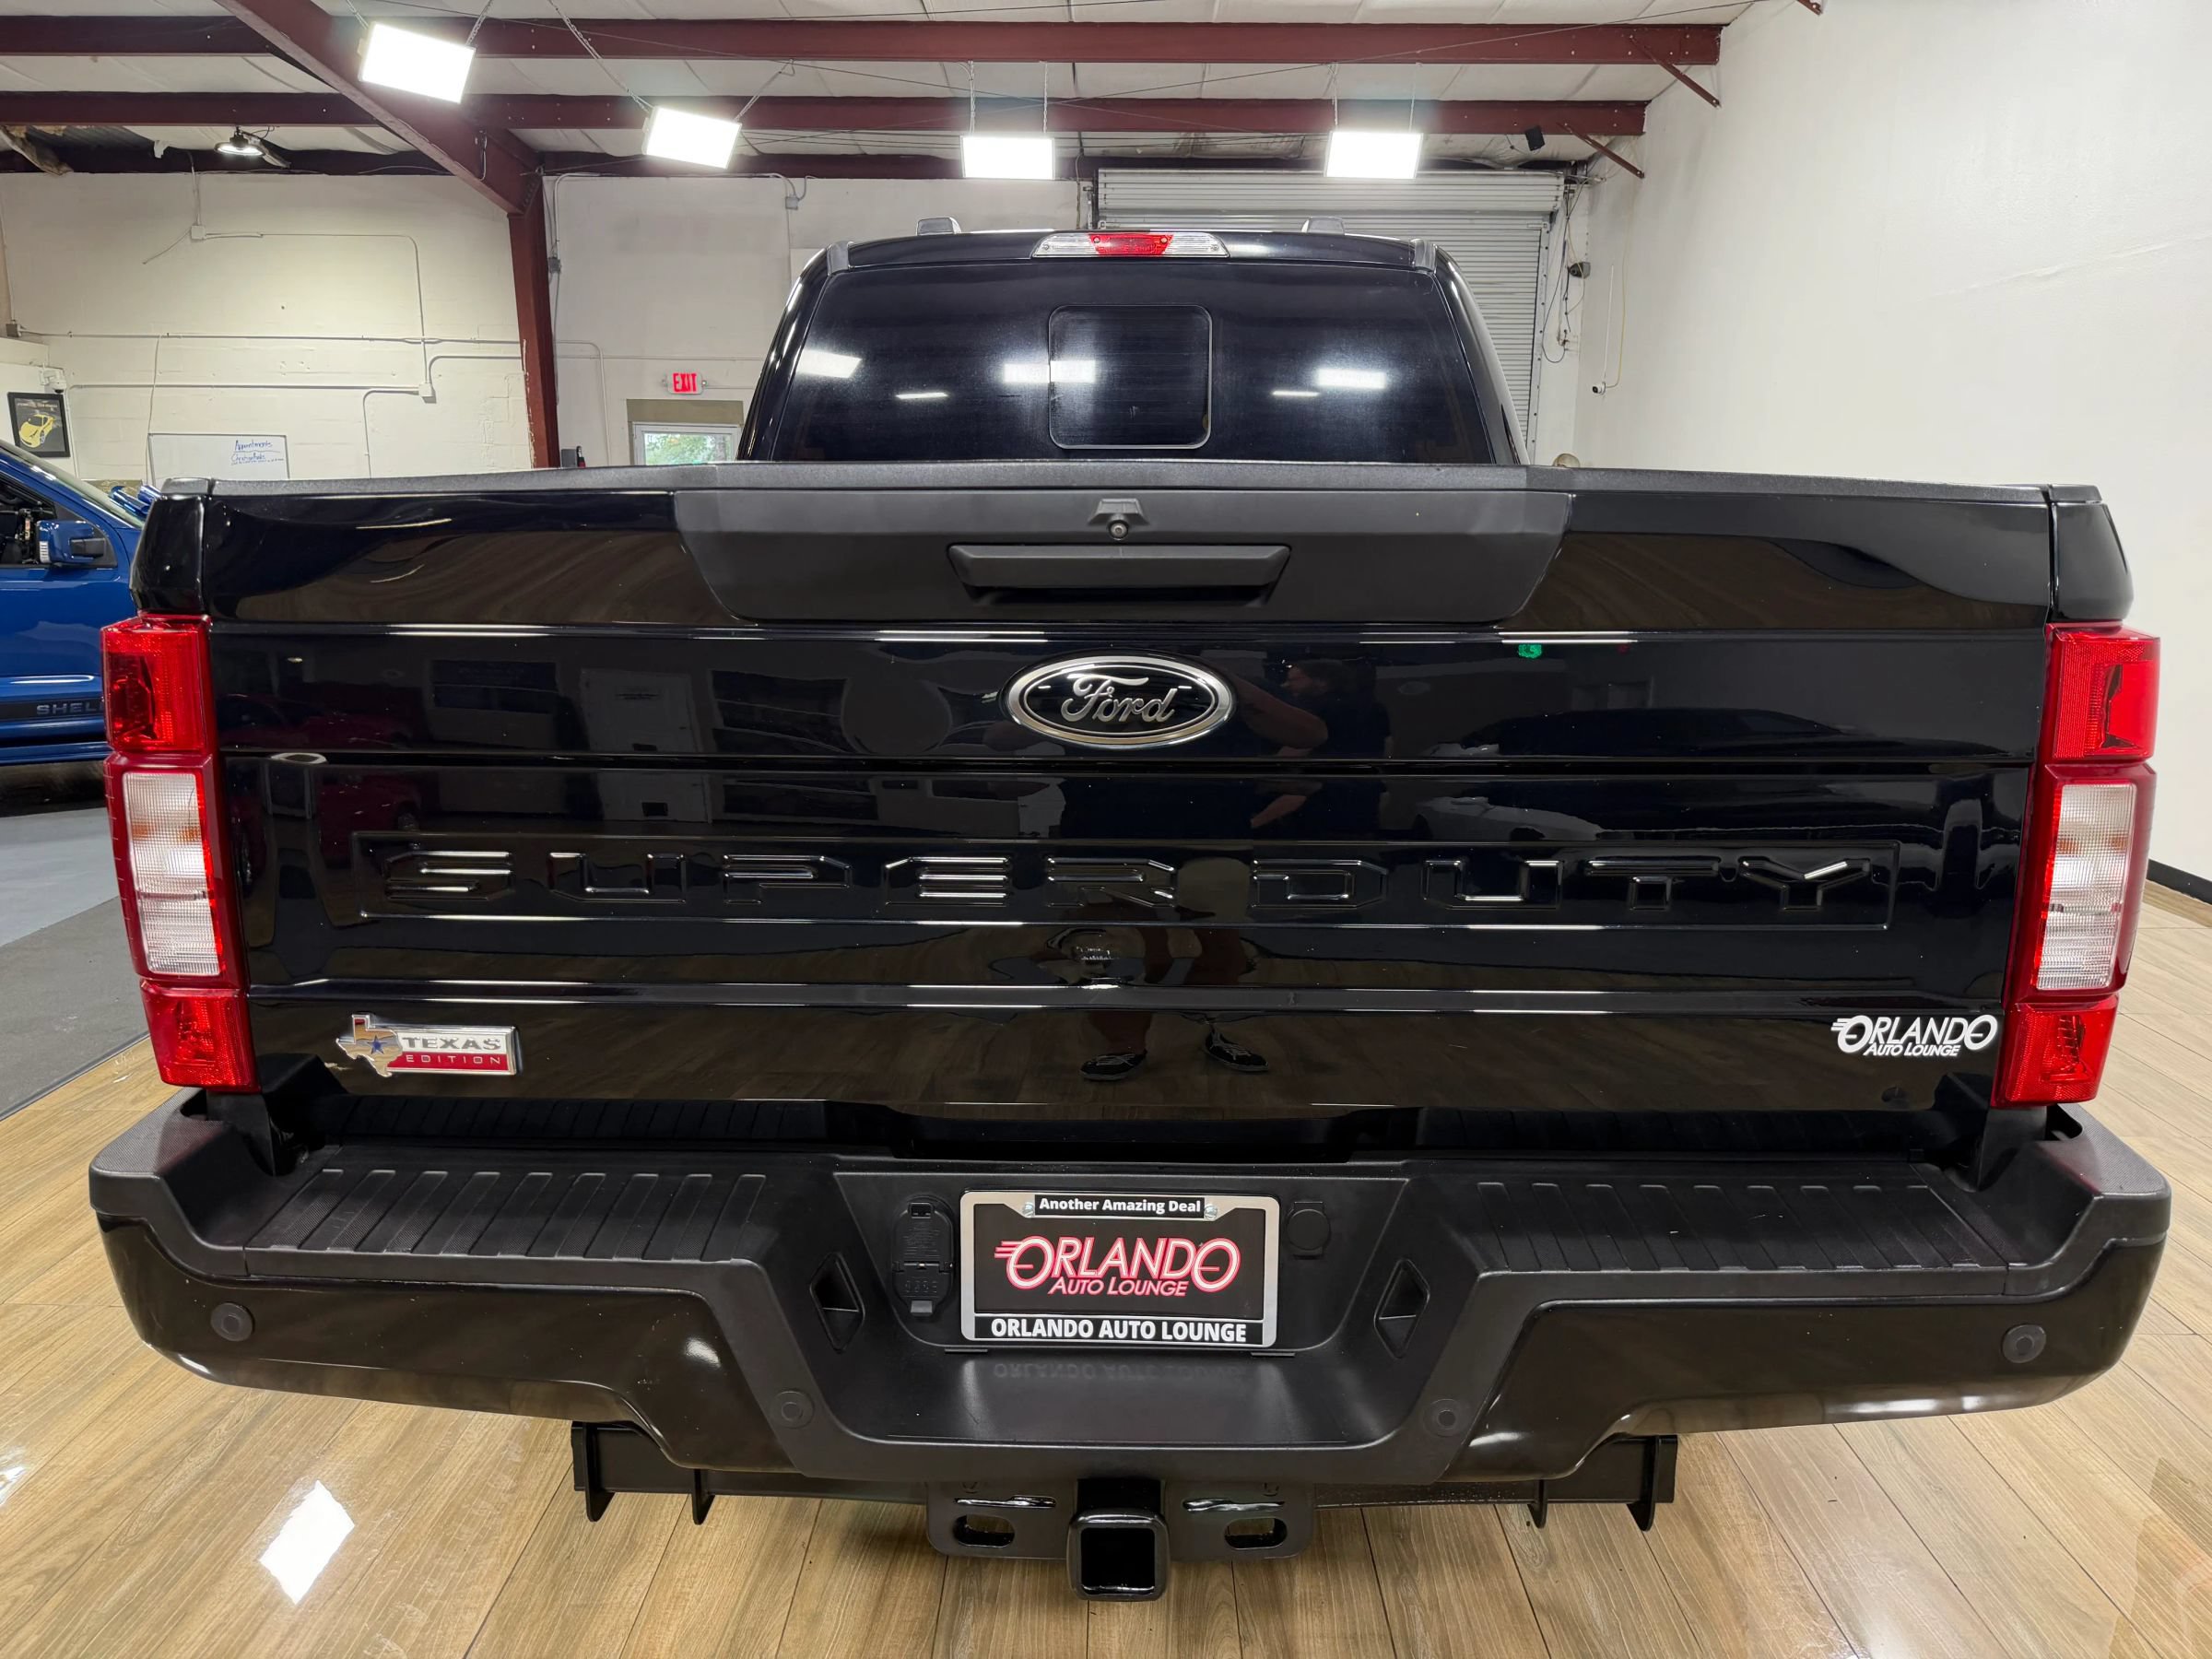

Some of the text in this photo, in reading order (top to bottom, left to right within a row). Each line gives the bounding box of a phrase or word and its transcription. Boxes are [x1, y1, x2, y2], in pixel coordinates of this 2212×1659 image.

[672, 372, 698, 393] EXIT
[1060, 673, 1178, 723] Ford
[385, 849, 1873, 911] SUPER DUTY
[402, 1036, 501, 1052] TEXAS
[1830, 1015, 1998, 1053] ORLANDO
[406, 1054, 501, 1065] EDITION
[1863, 1042, 1961, 1057] AUTO LOUNGE
[1039, 1197, 1201, 1214] Another Amazing Deal
[994, 1235, 1241, 1293] ORLANDO
[1047, 1277, 1189, 1297] AUTO LOUNGE
[991, 1318, 1247, 1343] ORLANDO AUTO LOUNGE
